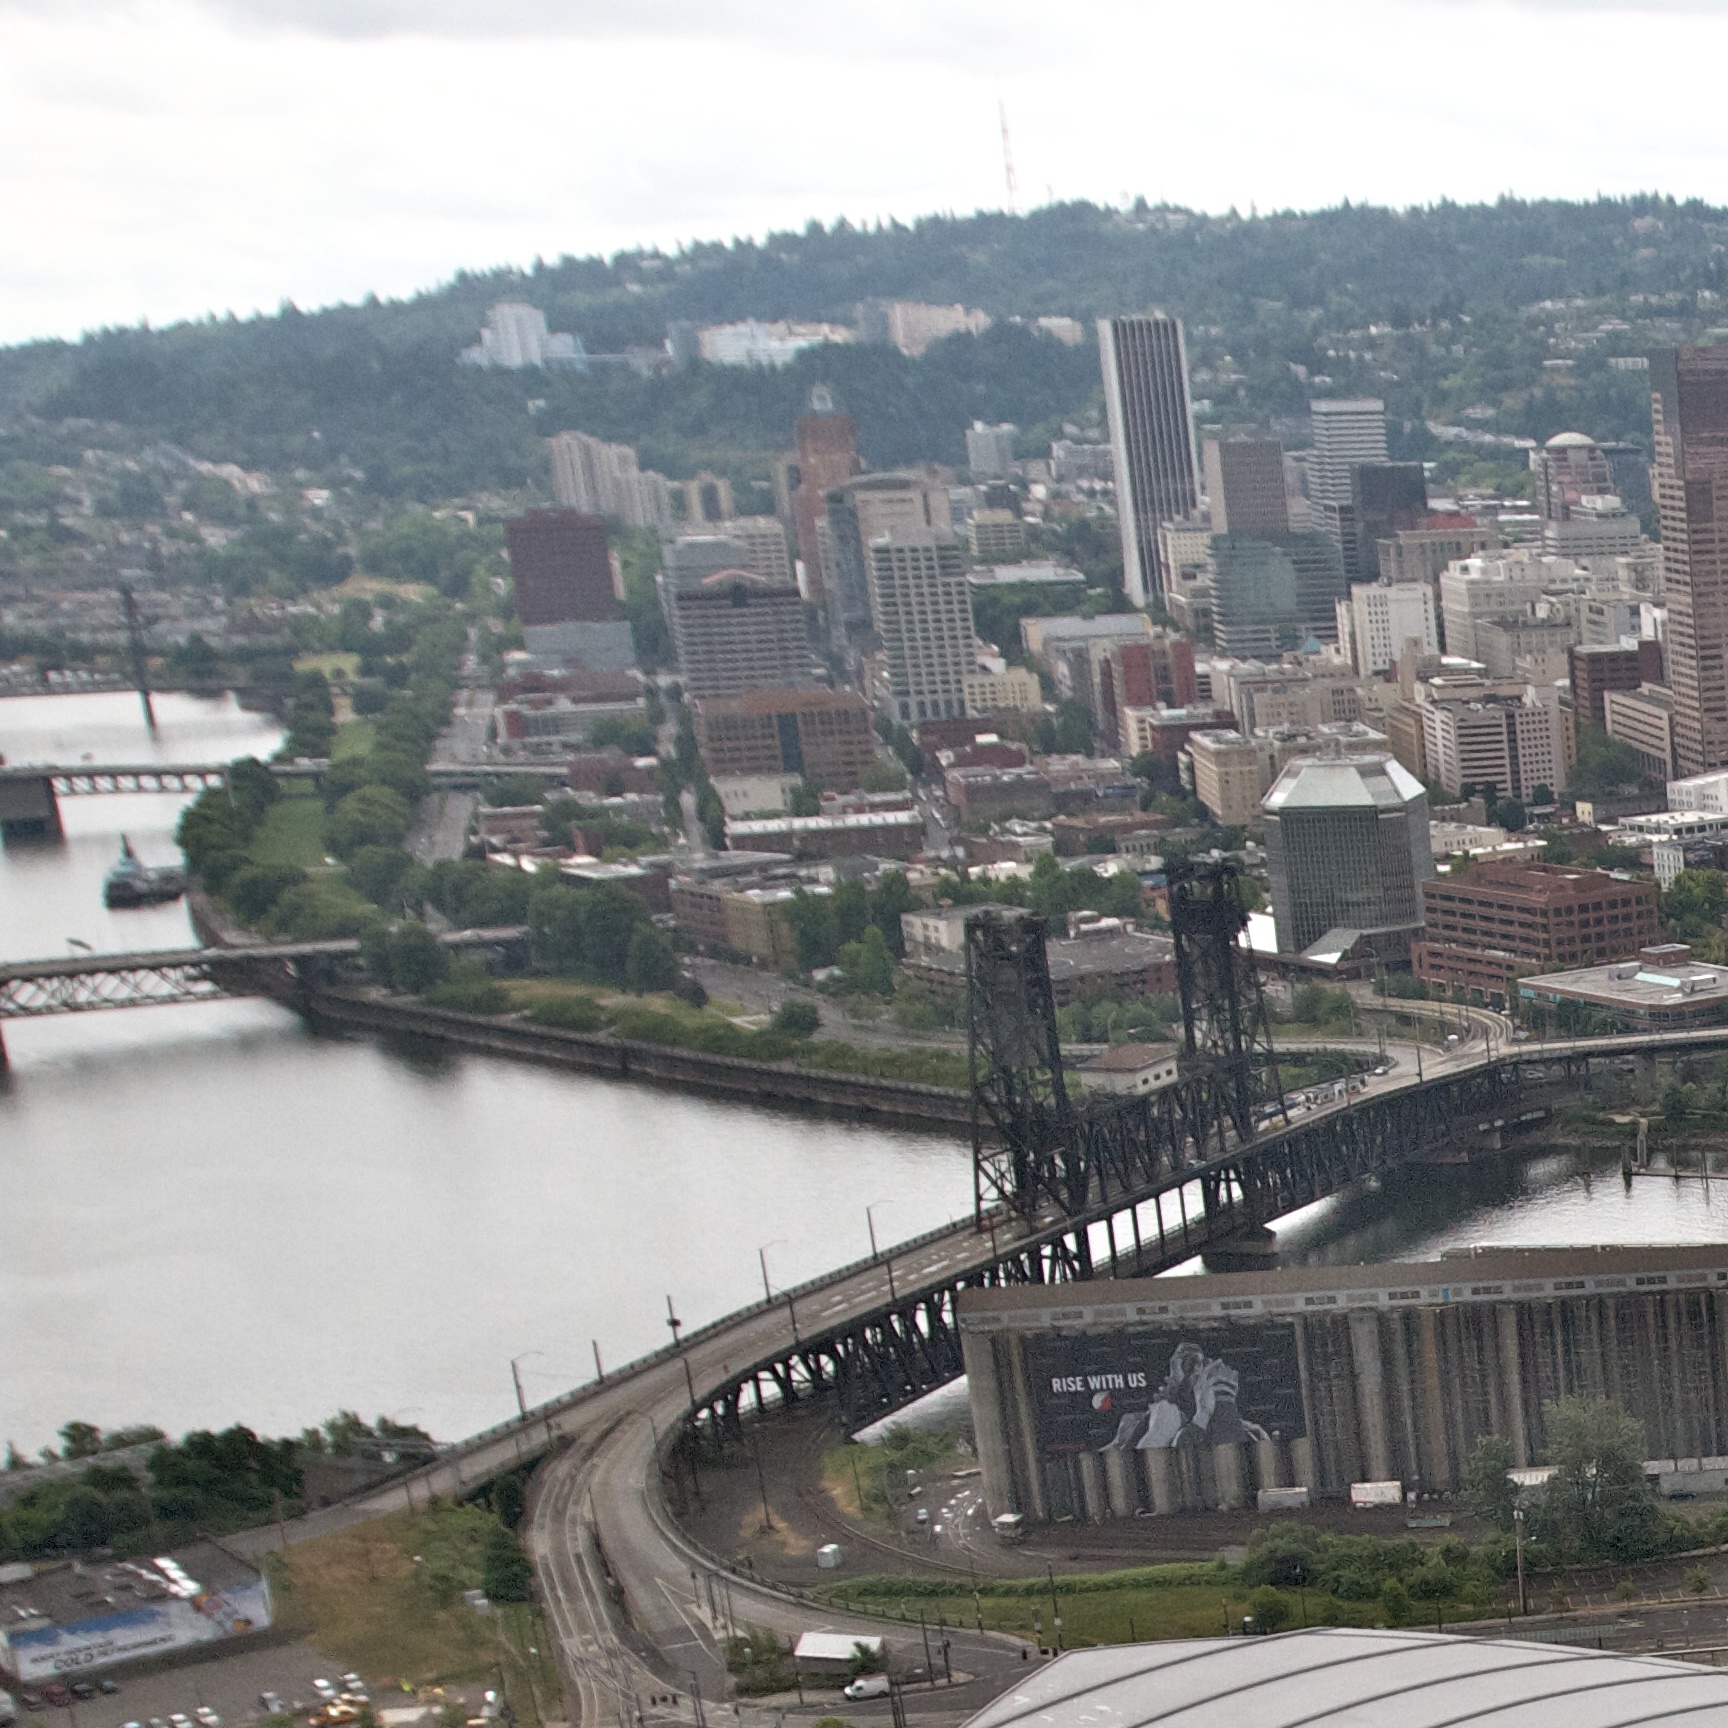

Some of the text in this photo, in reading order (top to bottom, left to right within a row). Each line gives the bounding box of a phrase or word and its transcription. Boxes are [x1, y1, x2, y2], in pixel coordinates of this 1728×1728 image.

[1052, 1372, 1147, 1393] RISE WITH US
